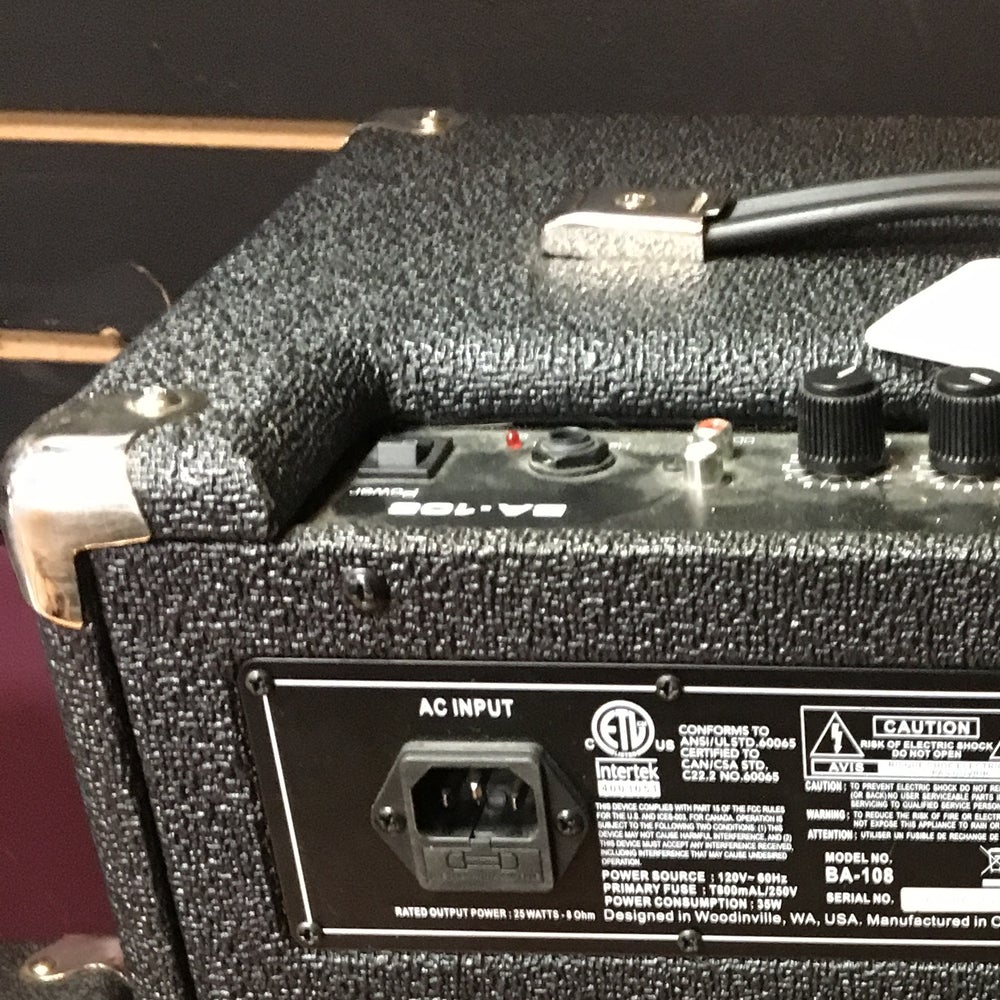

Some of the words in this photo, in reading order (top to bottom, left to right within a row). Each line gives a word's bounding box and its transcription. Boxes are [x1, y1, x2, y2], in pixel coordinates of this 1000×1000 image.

[419, 697, 448, 718] AC
[453, 698, 514, 718] INPUT
[679, 724, 749, 736] CONFORMS
[751, 726, 770, 737] TO
[884, 719, 970, 735] CAUTION
[860, 740, 885, 749] RISK
[887, 740, 901, 749] OF
[903, 741, 954, 750] ELECTRIC
[956, 742, 993, 751] SHOCK
[680, 748, 740, 759] CERTIFIED
[741, 749, 760, 760] TO
[892, 749, 907, 758] DO
[909, 750, 931, 759] NOT
[933, 750, 962, 759] OPEN
[596, 759, 661, 780] Intertek
[681, 759, 738, 770] CAN/CSA
[829, 762, 865, 773] AVIS
[850, 782, 859, 791] TO
[862, 782, 894, 791] PREVENT
[896, 783, 930, 792] ELECTRIC
[933, 783, 957, 792] SHOCK
[960, 784, 970, 792] DO
[972, 784, 987, 793] NOT
[900, 792, 919, 801] USER
[922, 792, 969, 801] SERVICEABLE
[971, 793, 994, 802] PARTS
[595, 802, 611, 811] THIS
[612, 802, 638, 811] DEVICE
[639, 803, 674, 812] COMPLIES
[674, 804, 692, 812] WITH
[693, 804, 711, 813] PART
[721, 804, 731, 813] OF
[732, 804, 745, 813] THE
[747, 805, 761, 813] FCC
[762, 805, 785, 814] RULES
[851, 800, 888, 809] SERVICING
[890, 801, 900, 809] TO
[902, 801, 938, 809] QUALIFIED
[941, 801, 970, 810] SERVICE
[853, 811, 862, 819] TO
[865, 811, 893, 819] REDUCE
[896, 811, 910, 820] THE
[912, 812, 928, 820] RISK
[931, 812, 940, 820] OF
[943, 812, 959, 820] FIRE
[961, 812, 972, 821] OR
[853, 820, 867, 828] NOT
[870, 820, 898, 829] EXPOSE
[901, 821, 916, 829] THIS
[918, 821, 956, 830] APPLIANCE
[958, 821, 968, 830] TO
[970, 822, 987, 830] RAIN
[989, 822, 1000, 830] OR
[825, 851, 869, 864] MODEL
[602, 869, 649, 882] POWER
[651, 870, 705, 883] SOURCE
[825, 866, 894, 884] BA-108
[603, 882, 661, 895] PRIMARY
[663, 883, 697, 896] FUSE
[604, 895, 652, 908] POWER
[654, 896, 747, 910] CONSUMPTION
[826, 892, 871, 905] SERIAL
[394, 906, 427, 918] RATED
[429, 907, 468, 919] OUTPUT
[470, 908, 506, 919] POWER
[514, 908, 525, 920] 25
[526, 909, 559, 920] WATTS
[574, 910, 595, 920] Ohm
[604, 908, 674, 925] Designed
[678, 910, 691, 923] in
[694, 910, 786, 926] Woodinville,
[866, 914, 970, 928] Manufactured
[973, 915, 989, 928] in
